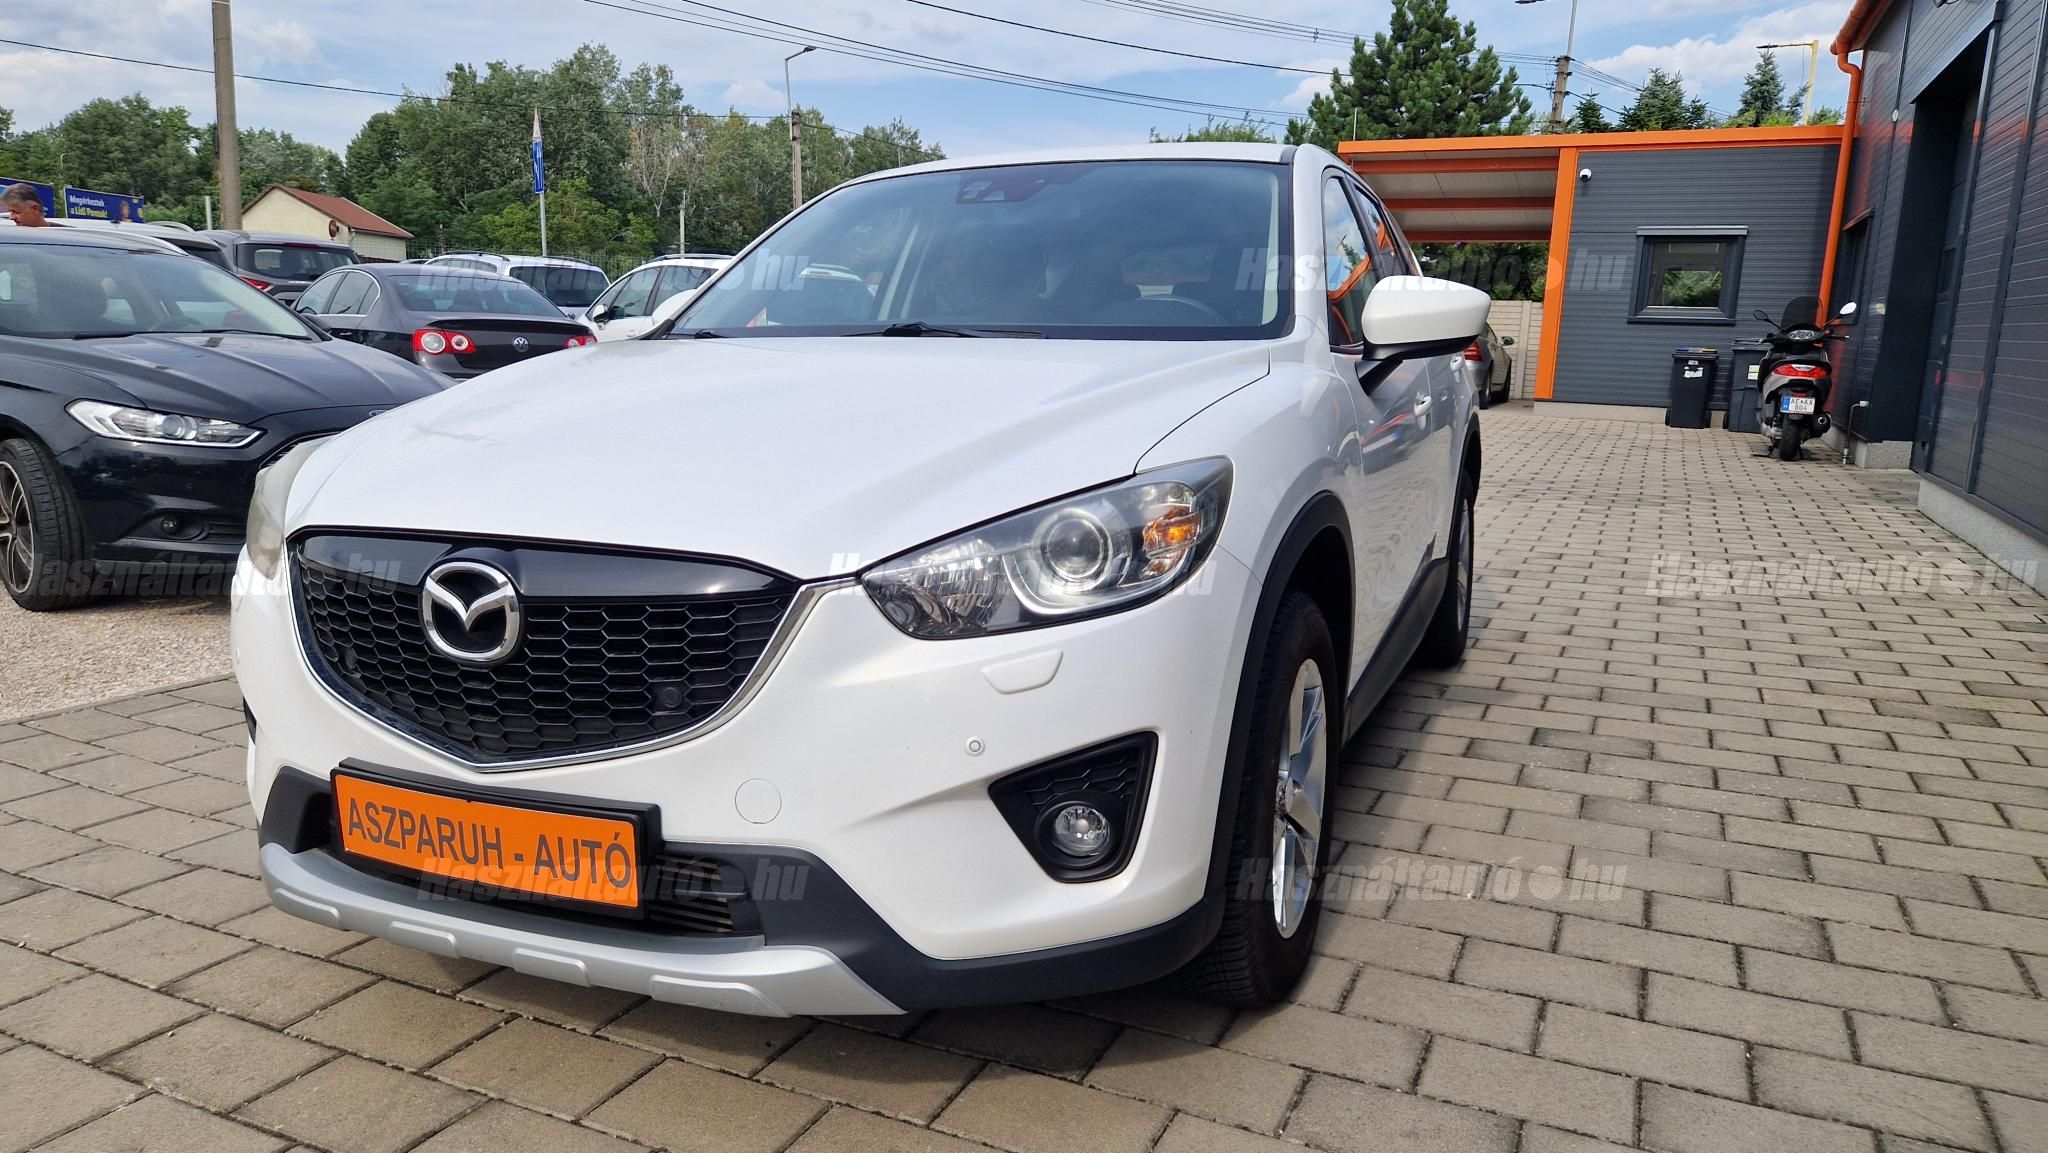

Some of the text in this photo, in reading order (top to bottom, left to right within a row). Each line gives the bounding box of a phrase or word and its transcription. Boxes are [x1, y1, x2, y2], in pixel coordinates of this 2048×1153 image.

[75, 207, 86, 216] Lidl
[348, 798, 504, 870] ASZPARUH
[533, 832, 632, 889] AUTÓ
